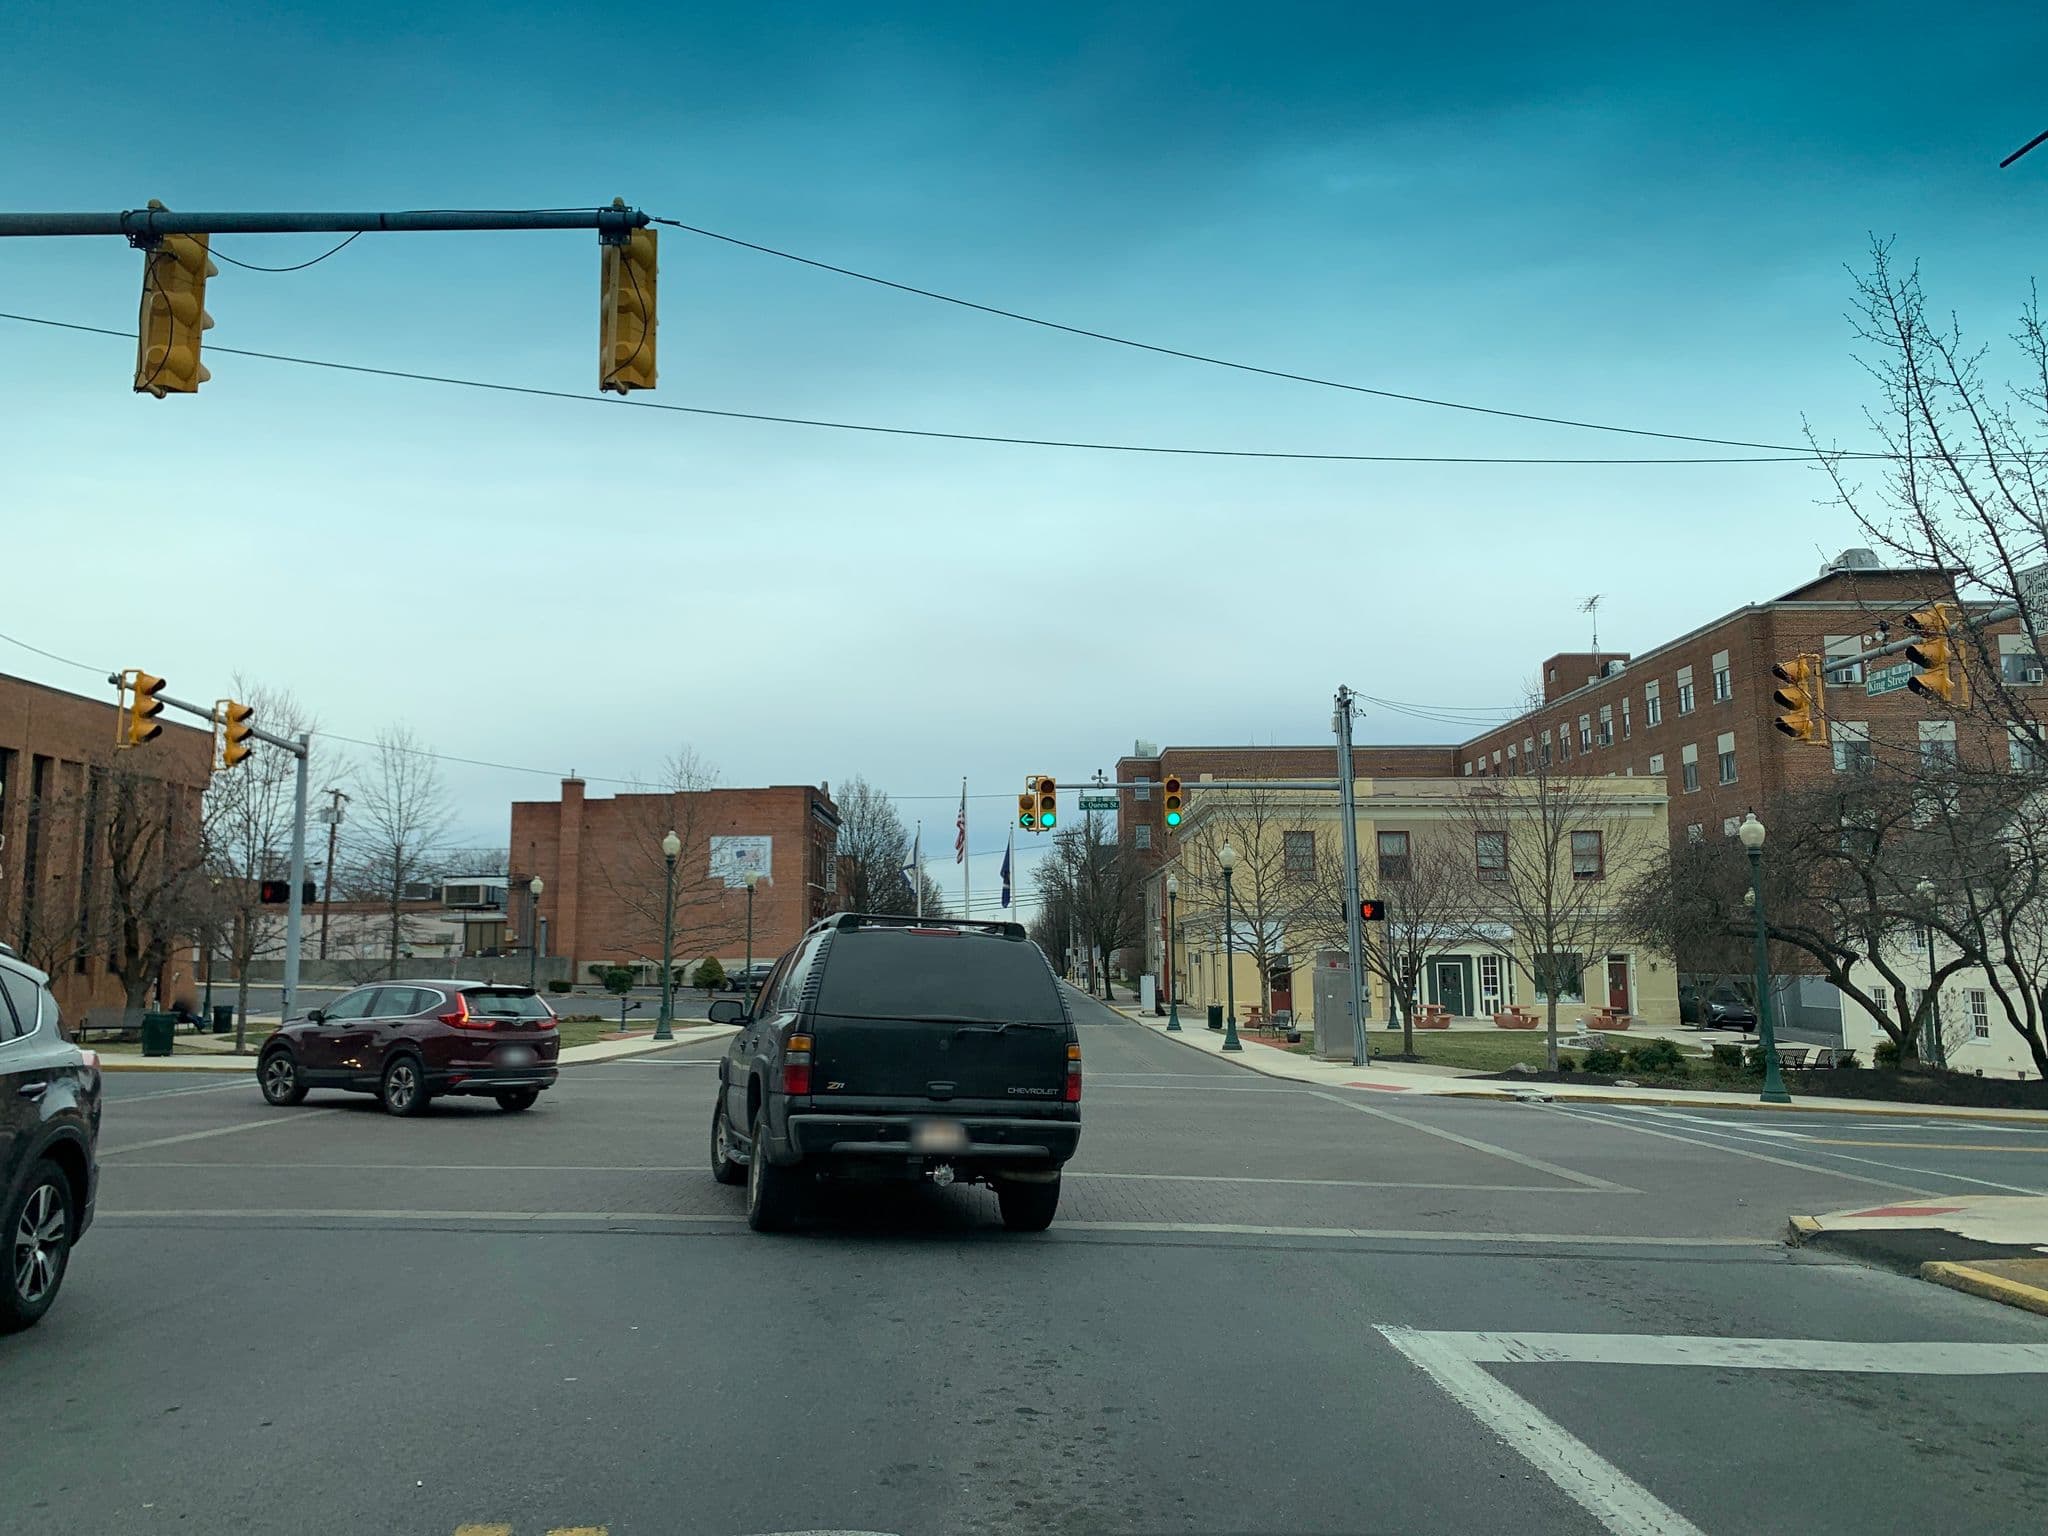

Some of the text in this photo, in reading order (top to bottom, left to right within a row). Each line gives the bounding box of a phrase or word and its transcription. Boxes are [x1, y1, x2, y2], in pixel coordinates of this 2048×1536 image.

[1868, 680, 1886, 692] King
[1088, 801, 1108, 809] Queen
[1007, 1087, 1059, 1095] CHEVROLET
